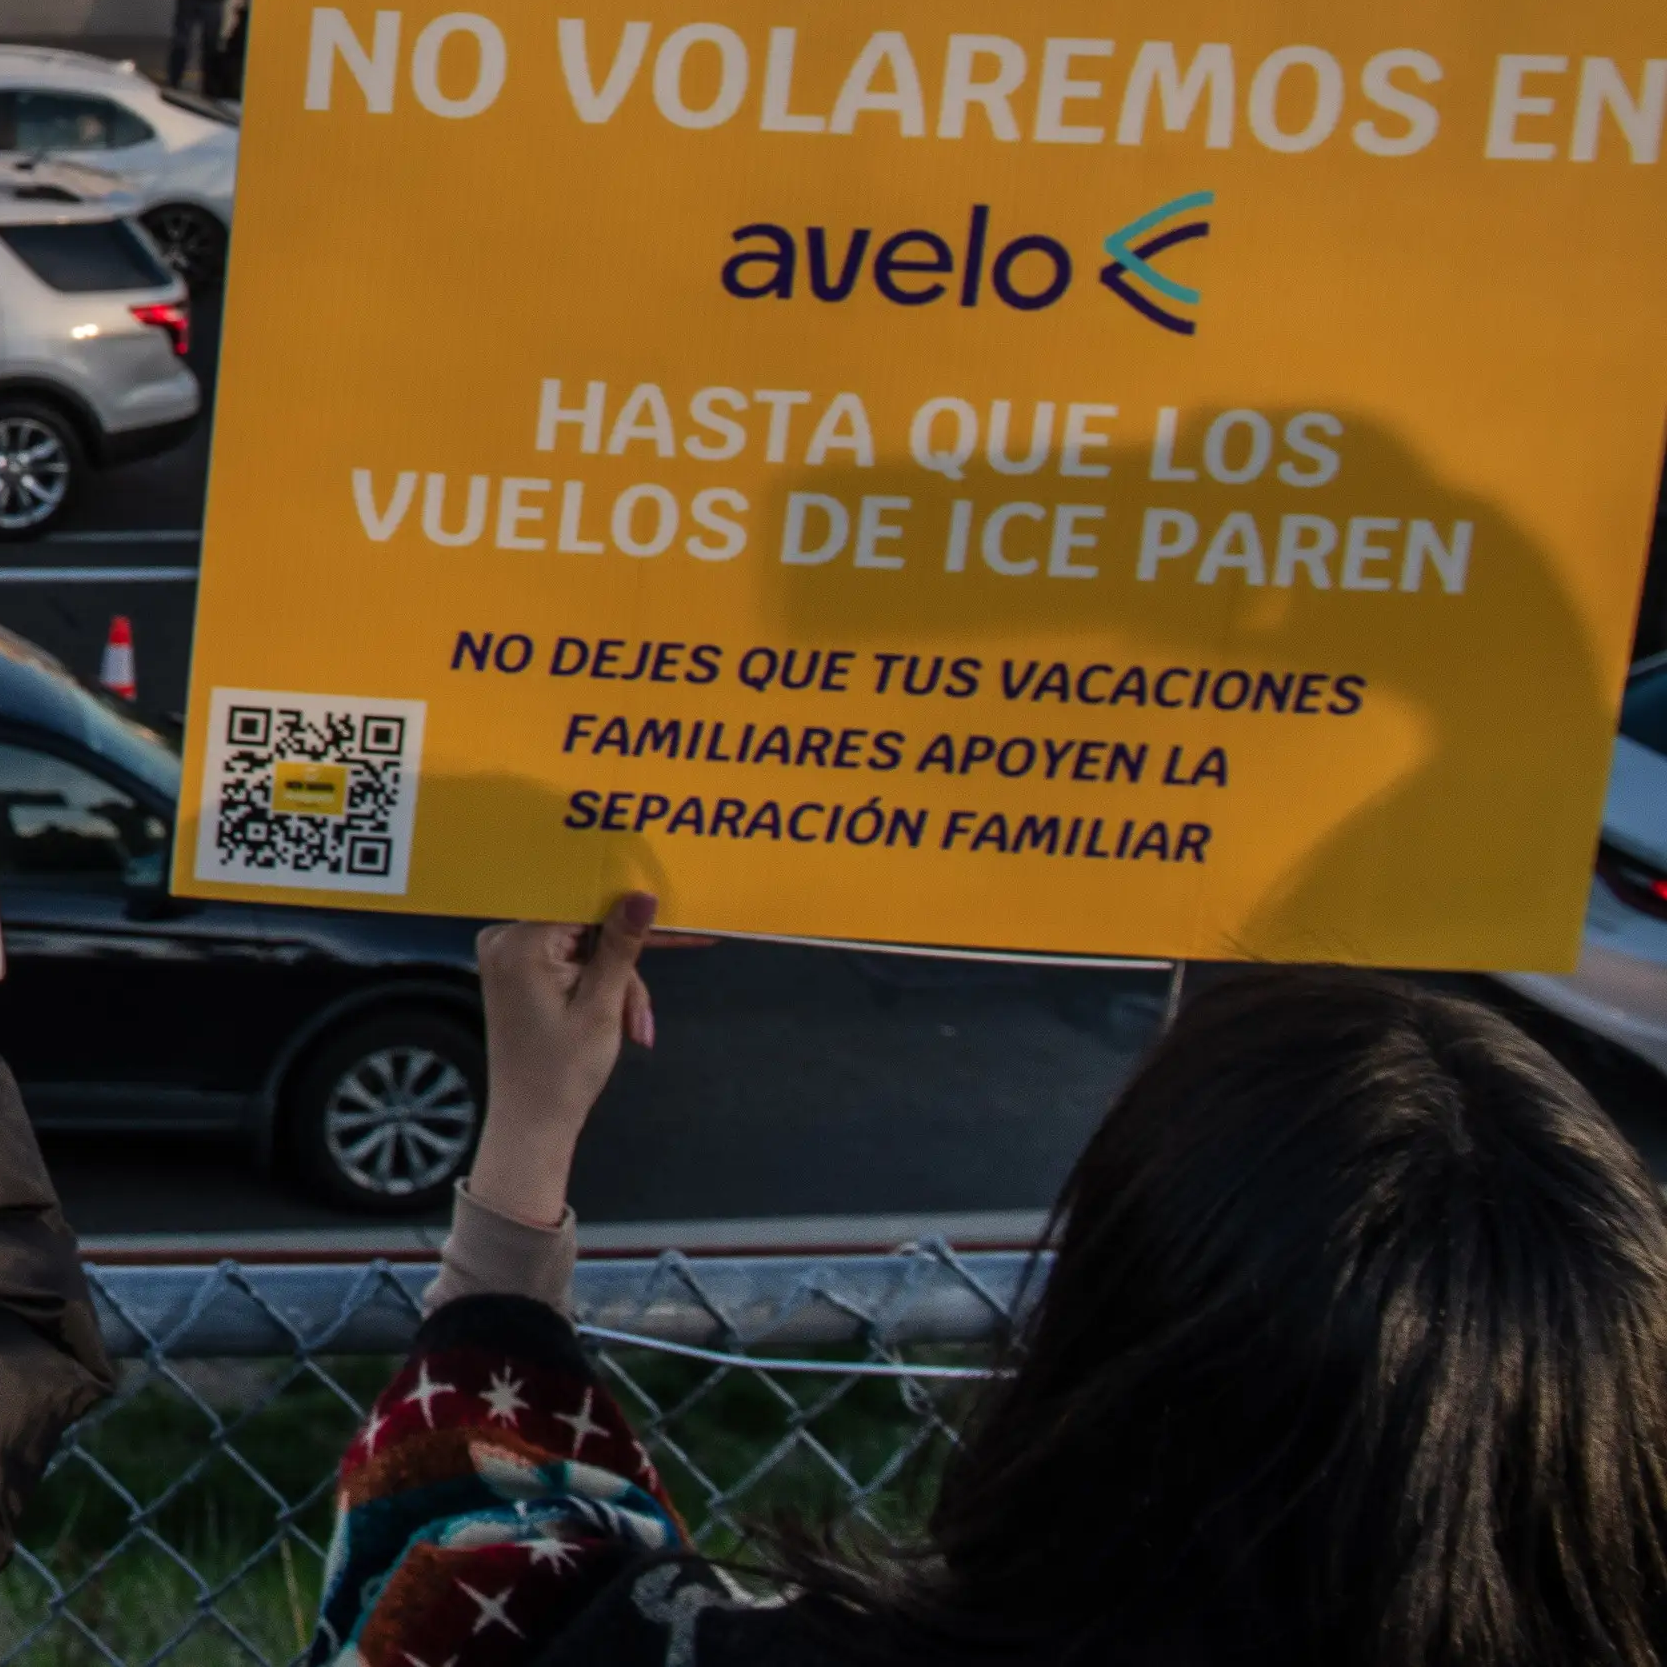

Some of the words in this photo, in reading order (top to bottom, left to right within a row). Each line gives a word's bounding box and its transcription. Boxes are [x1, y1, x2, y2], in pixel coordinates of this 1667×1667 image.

[301, 5, 509, 120] NO
[556, 17, 1445, 158] VOLAREMOS
[1484, 53, 1667, 165] EN
[720, 203, 1074, 312] avelo
[533, 377, 874, 469] HASTA
[908, 396, 1120, 483] QUE
[1149, 406, 1345, 489] LOS
[350, 468, 750, 563] VUELOS
[779, 491, 913, 572] DE
[944, 498, 1103, 580] ICE
[1135, 507, 1474, 596] PAREN
[450, 630, 534, 675] NO
[549, 636, 723, 686] DEJES
[737, 646, 857, 695] QUE
[872, 652, 981, 700] TUS
[1000, 659, 1368, 717] VACACIONES
[562, 713, 905, 772] FAMILIARES
[918, 735, 1149, 788] APOYEN
[1160, 744, 1230, 789] LA
[562, 789, 927, 849] SEPARACIÓN
[940, 810, 1213, 864] FAMILIAR
